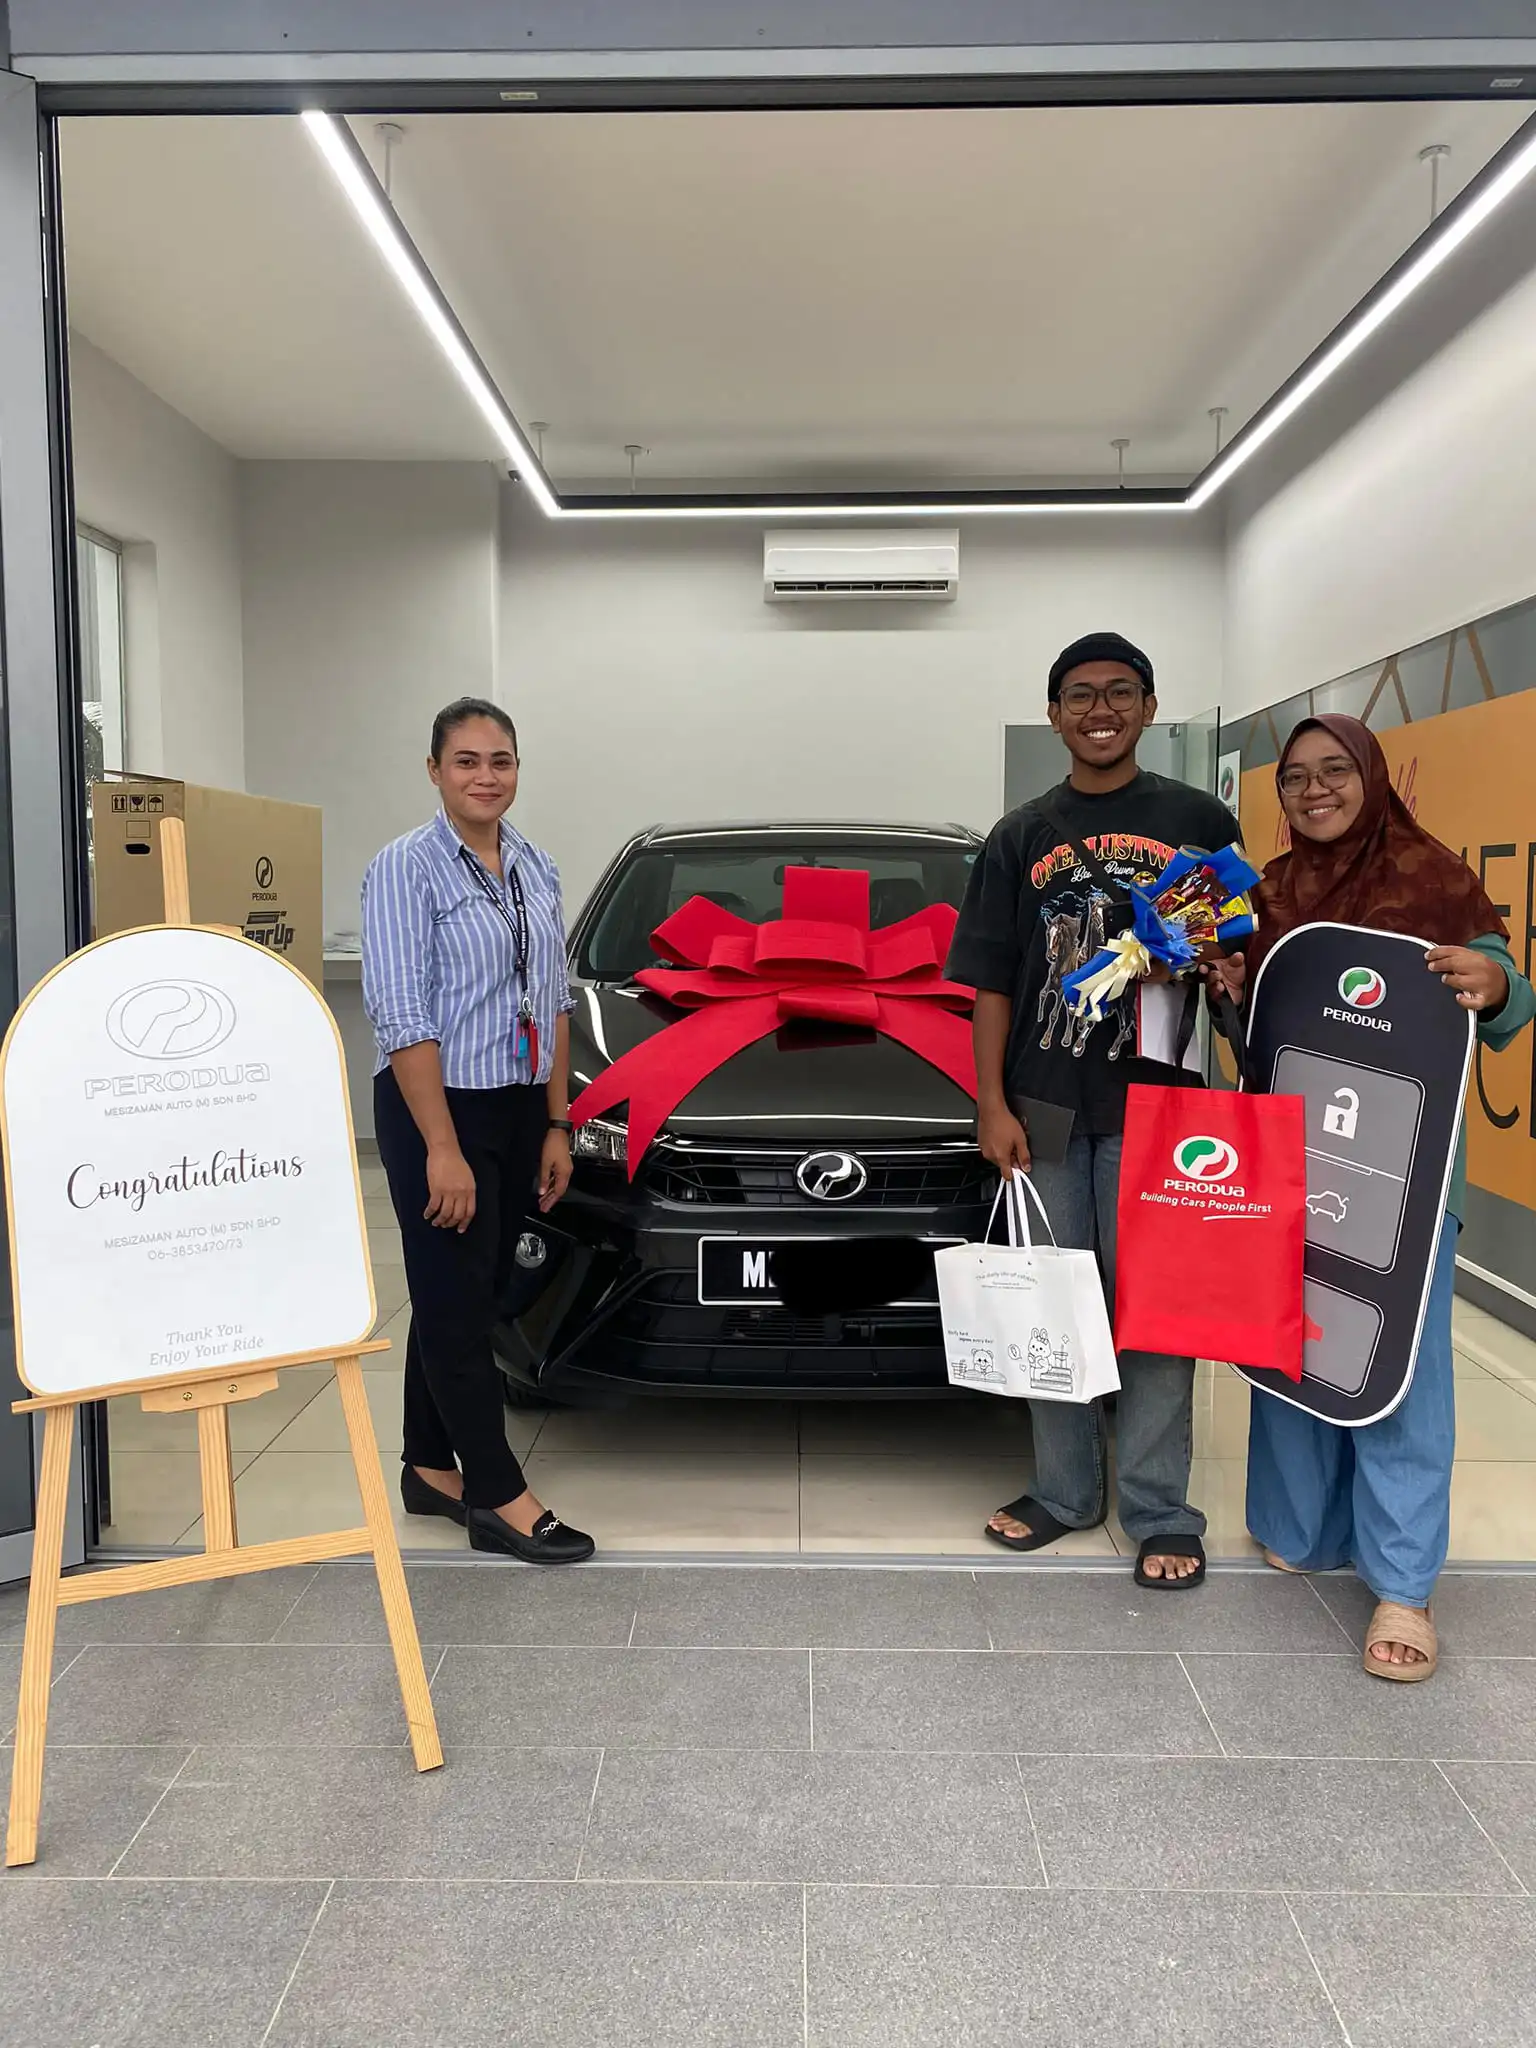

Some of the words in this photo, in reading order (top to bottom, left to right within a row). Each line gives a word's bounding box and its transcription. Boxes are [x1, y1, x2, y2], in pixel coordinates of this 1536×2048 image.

[104, 1103, 163, 1117] MESIZAMAN
[166, 1099, 193, 1111] AUTO
[196, 1098, 211, 1109] (M)
[213, 1096, 234, 1106] SDN
[236, 1092, 258, 1104] BHD
[67, 1148, 306, 1212] Congratulations
[1140, 1191, 1179, 1207] Building
[1180, 1197, 1206, 1208] Cars
[1208, 1200, 1247, 1213] People
[1247, 1203, 1272, 1213] First
[104, 1231, 173, 1250] MESIZAMAN
[176, 1226, 207, 1240] AUTO
[210, 1223, 228, 1237] (M)
[230, 1219, 254, 1233] SDN
[257, 1216, 282, 1229] BHD
[147, 1237, 244, 1261] 06-3853470/73
[166, 1327, 213, 1346] Thank
[215, 1324, 243, 1338] You
[149, 1350, 190, 1367] Enjoy
[195, 1342, 229, 1358] Your
[232, 1336, 264, 1352] Ride
